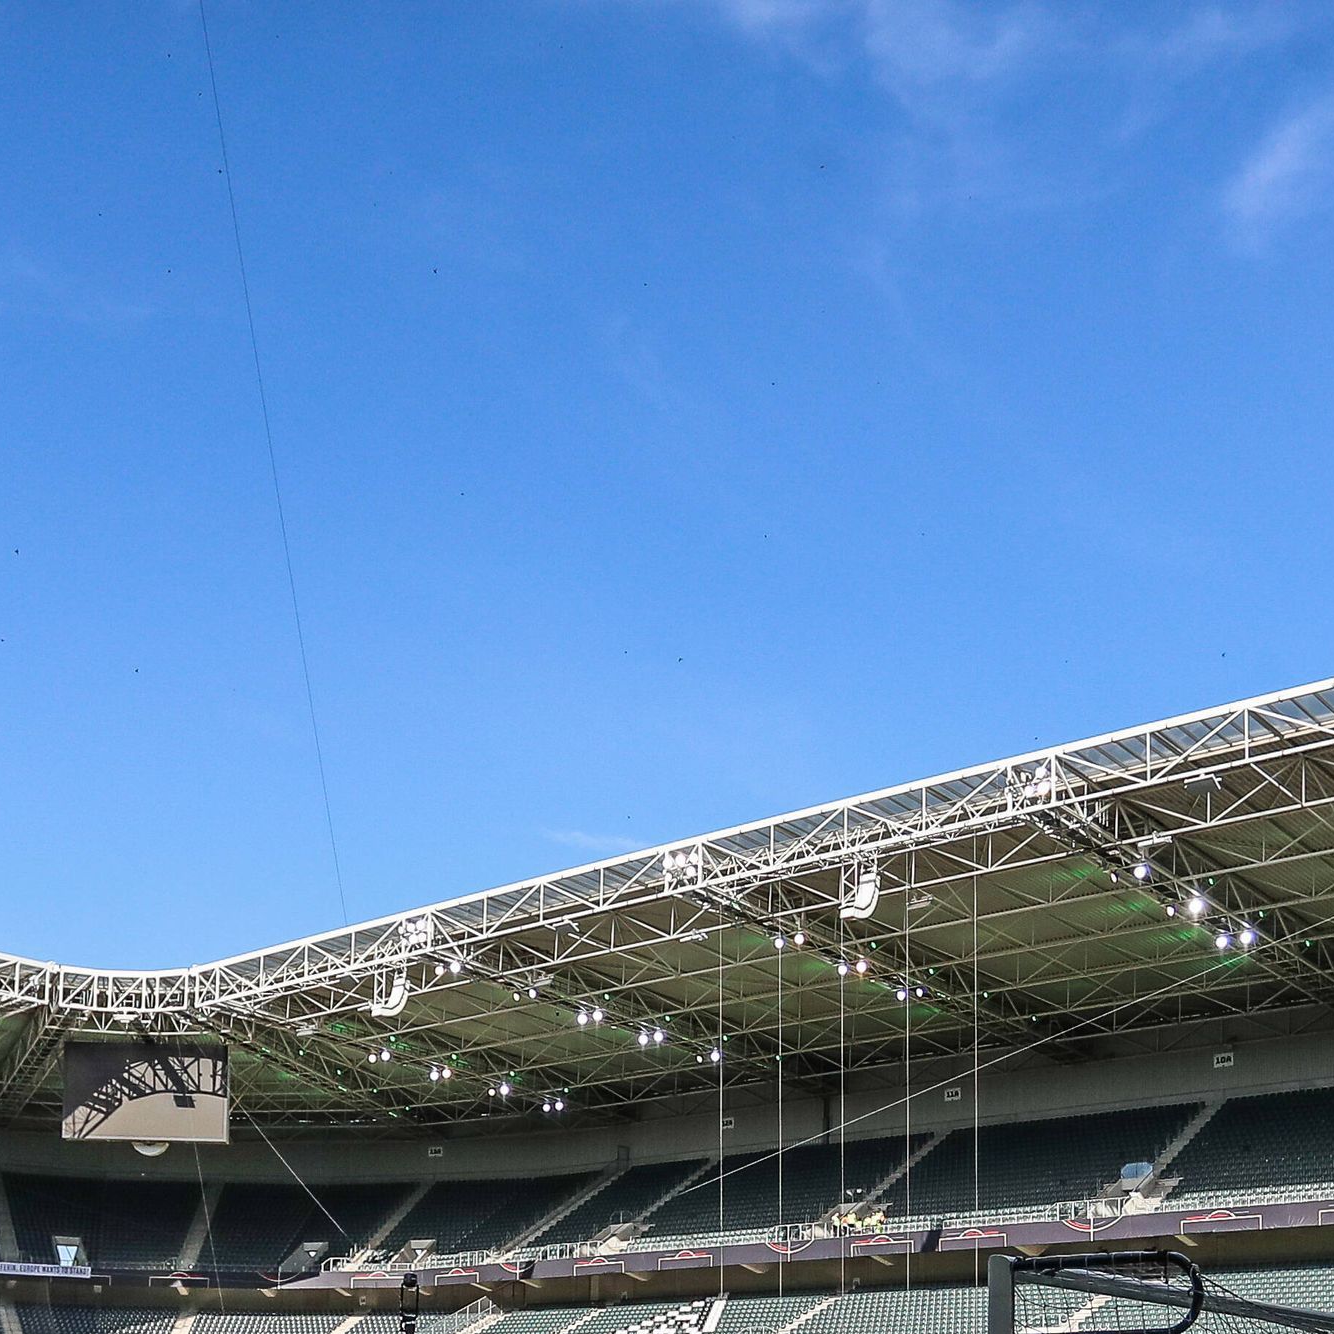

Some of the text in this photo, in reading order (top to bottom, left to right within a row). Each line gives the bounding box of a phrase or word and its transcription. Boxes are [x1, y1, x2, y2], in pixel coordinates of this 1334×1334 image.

[1215, 1053, 1232, 1064] 10A
[19, 1264, 40, 1273] EUROPE
[41, 1265, 60, 1275] WANTS
